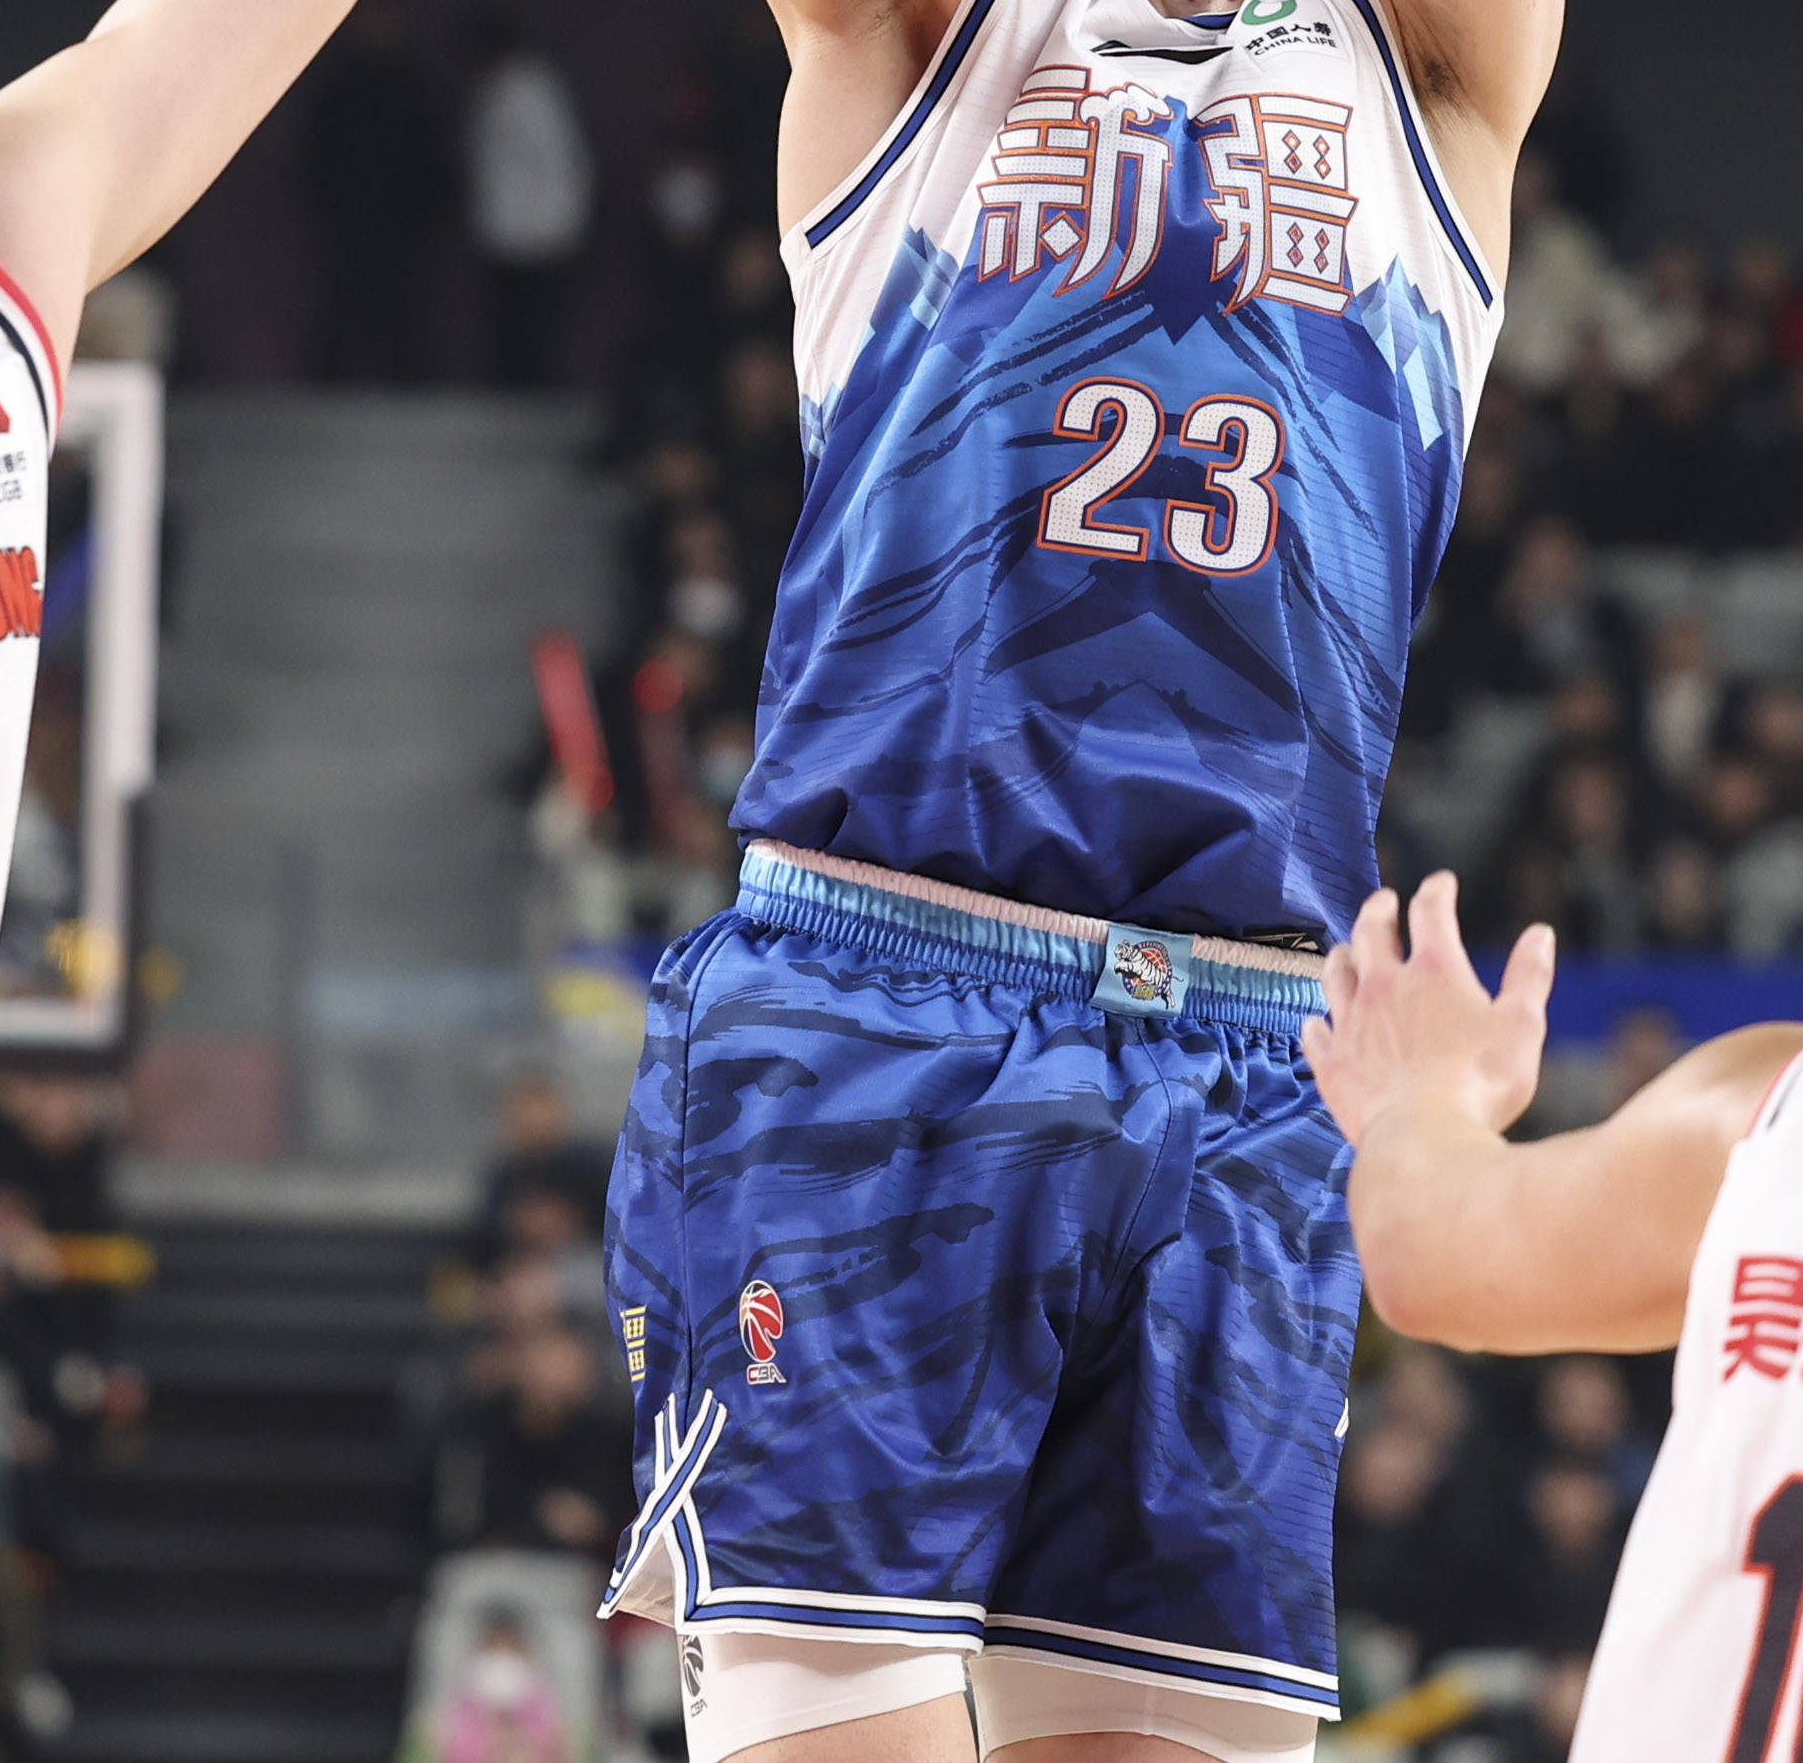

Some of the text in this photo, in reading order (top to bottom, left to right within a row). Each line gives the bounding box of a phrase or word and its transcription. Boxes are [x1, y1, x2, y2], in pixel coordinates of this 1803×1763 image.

[1246, 21, 1332, 50] 中国人寿
[1254, 36, 1337, 56] CHINA LIFE
[977, 64, 1359, 316] 新疆
[1037, 375, 1285, 576] 23
[747, 1363, 786, 1384] CBA
